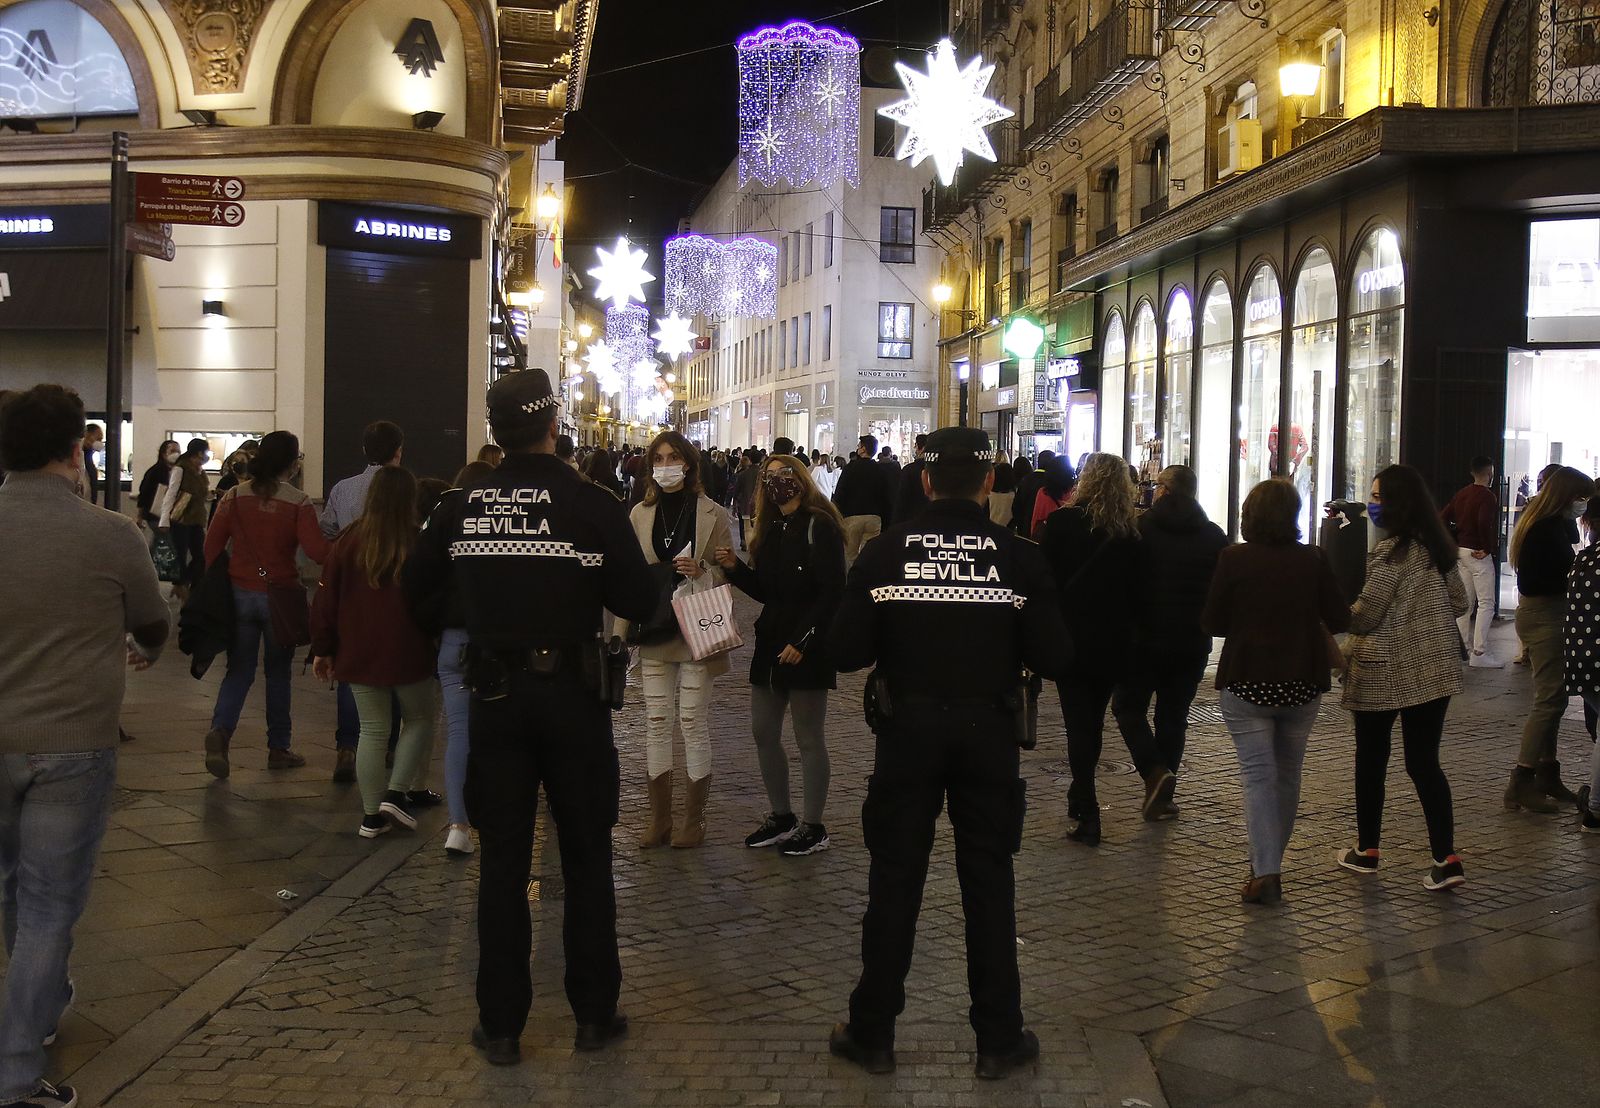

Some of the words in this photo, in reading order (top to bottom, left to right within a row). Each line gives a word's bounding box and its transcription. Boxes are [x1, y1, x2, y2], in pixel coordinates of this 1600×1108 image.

[162, 177, 181, 185] Barrio
[191, 178, 211, 186] Triana
[140, 202, 167, 210] Parroquia
[181, 204, 211, 212] Magdalena
[355, 220, 452, 241] ABRINES
[860, 384, 930, 404] Stradivarius
[468, 488, 552, 504] POLICIA
[485, 505, 529, 515] LOCAL
[463, 517, 551, 535] SEVILLA
[905, 534, 997, 551] POLICIA
[928, 550, 975, 562] LOCAL
[904, 562, 1000, 582] SEVILLA
